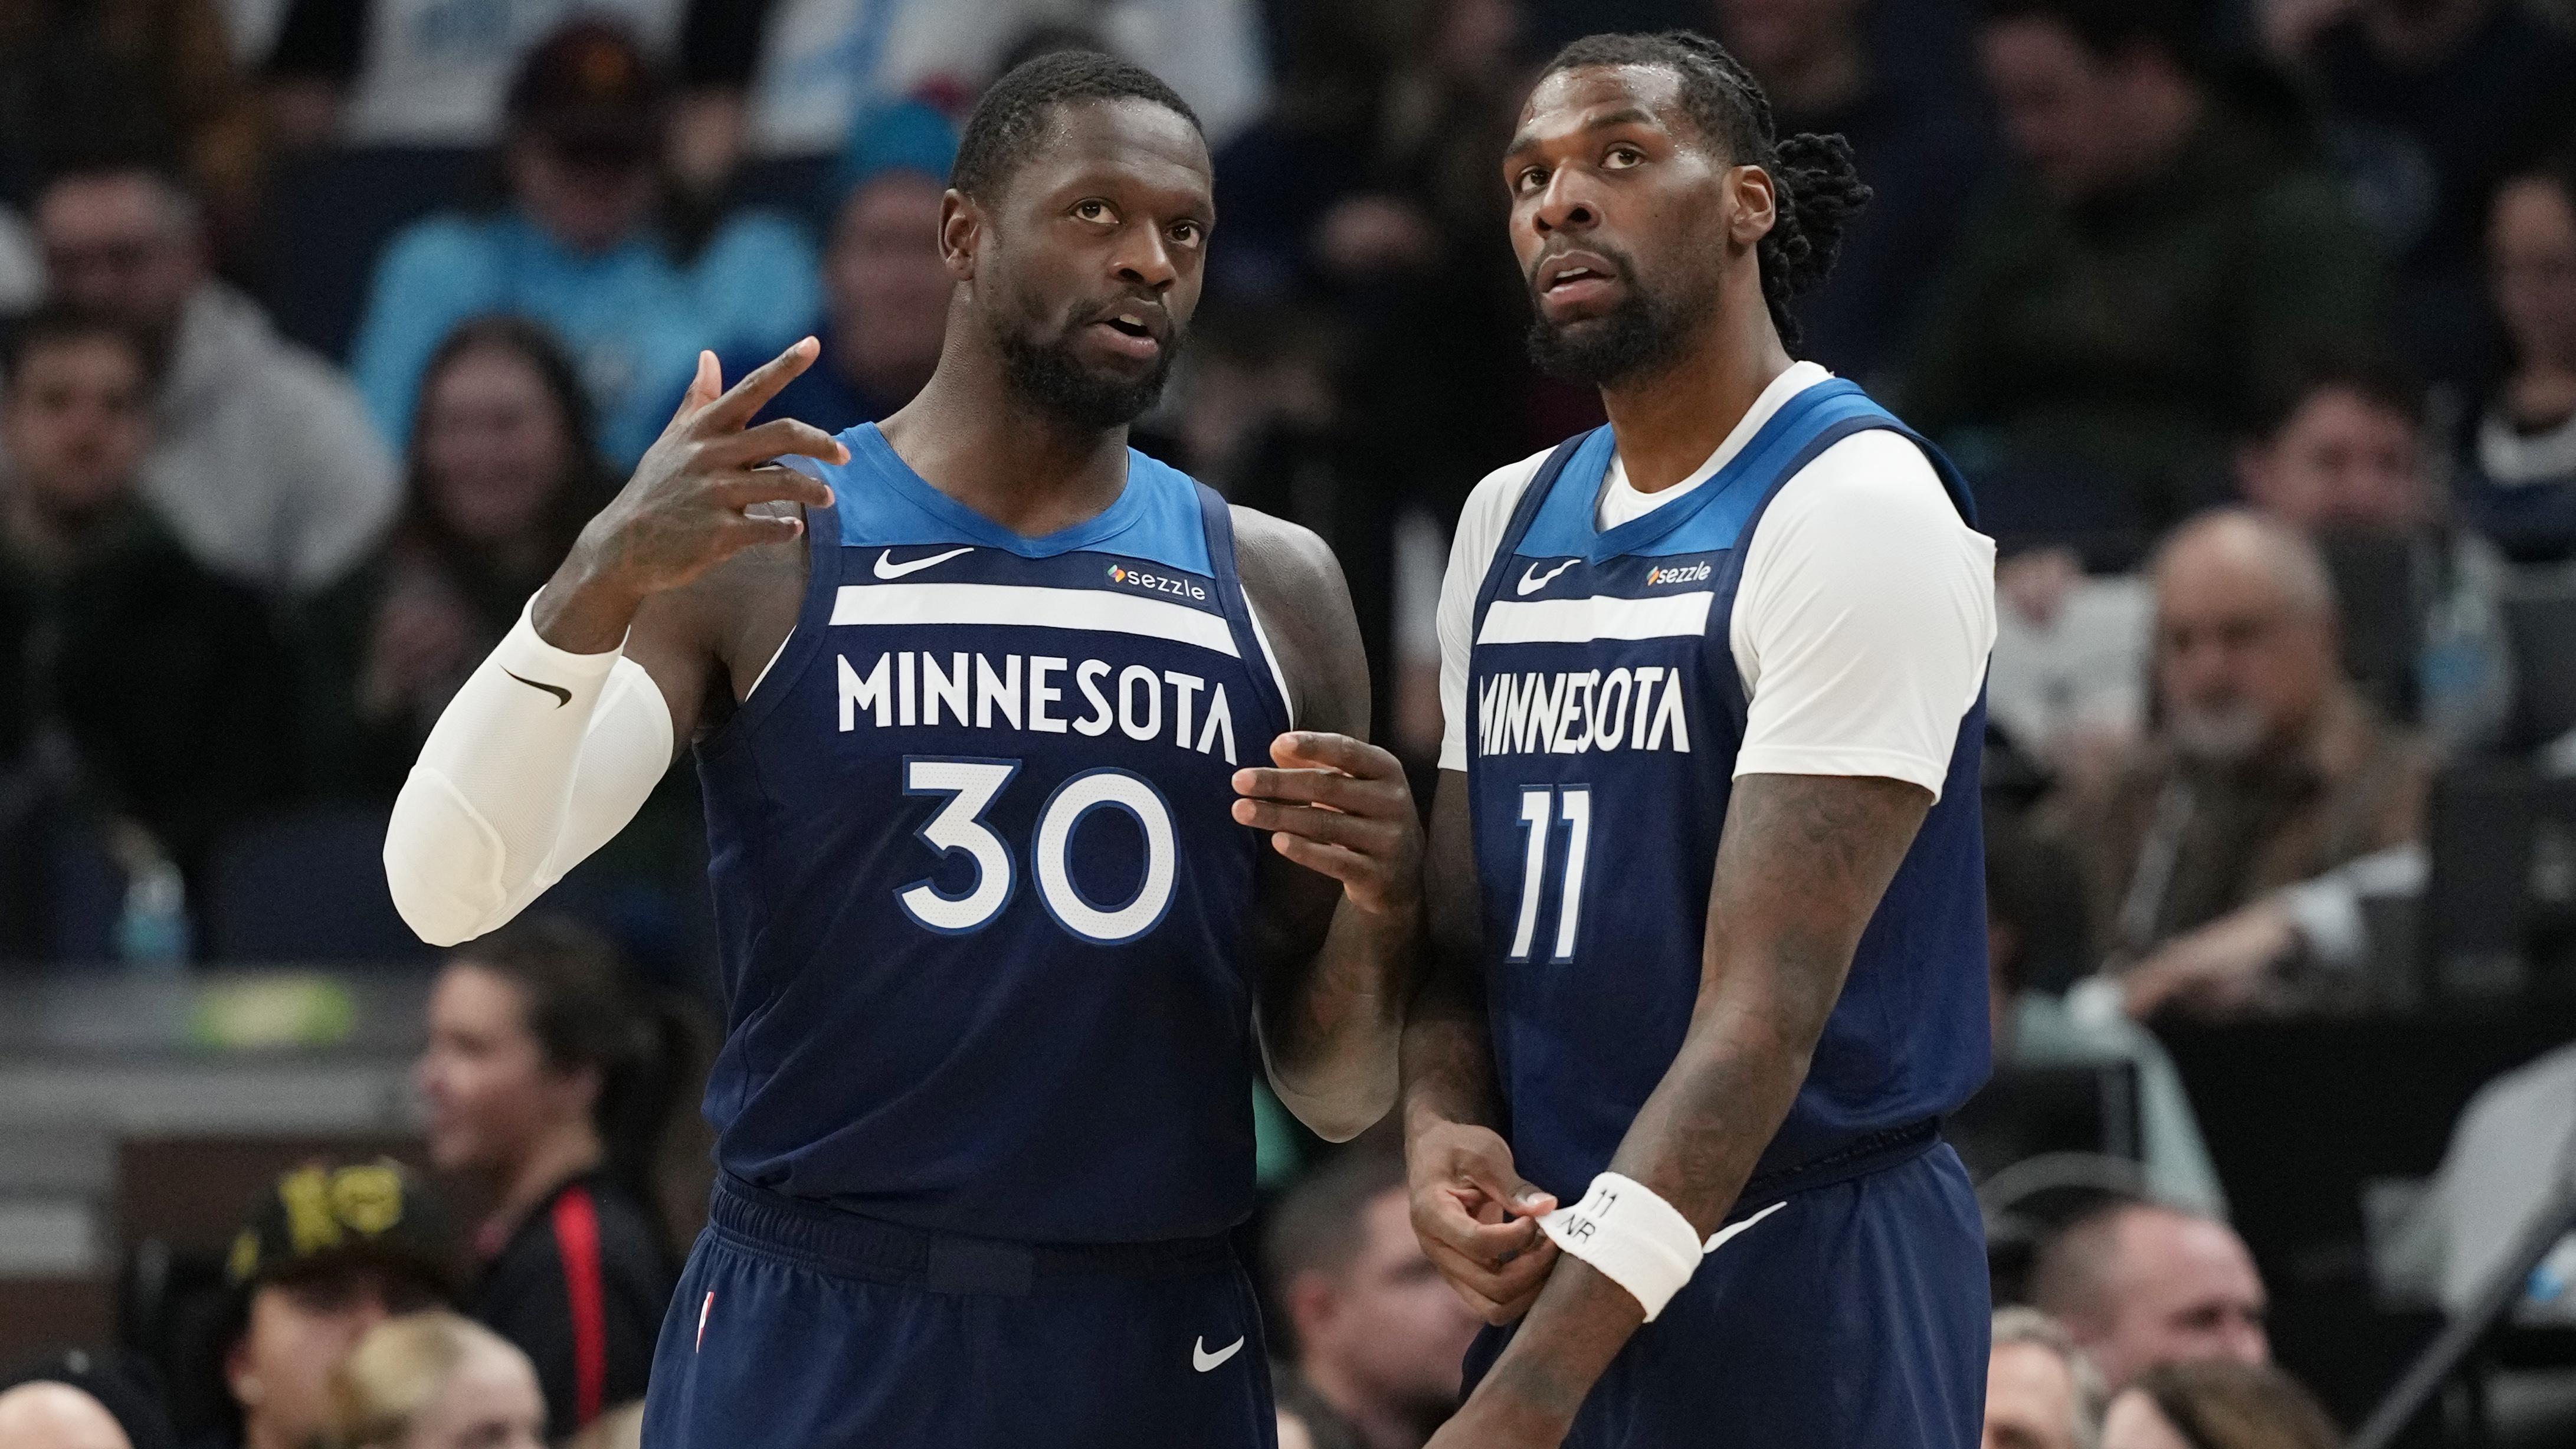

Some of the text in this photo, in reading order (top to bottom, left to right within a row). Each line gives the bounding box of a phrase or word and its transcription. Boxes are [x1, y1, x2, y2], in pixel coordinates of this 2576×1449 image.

[1127, 570, 1205, 601] sezzle
[1656, 560, 1711, 584] sezzle
[837, 651, 1238, 766] MINNESOTA
[1478, 667, 1691, 759] MINNESOTA
[893, 755, 1180, 945] 30
[1505, 783, 1592, 964] 11
